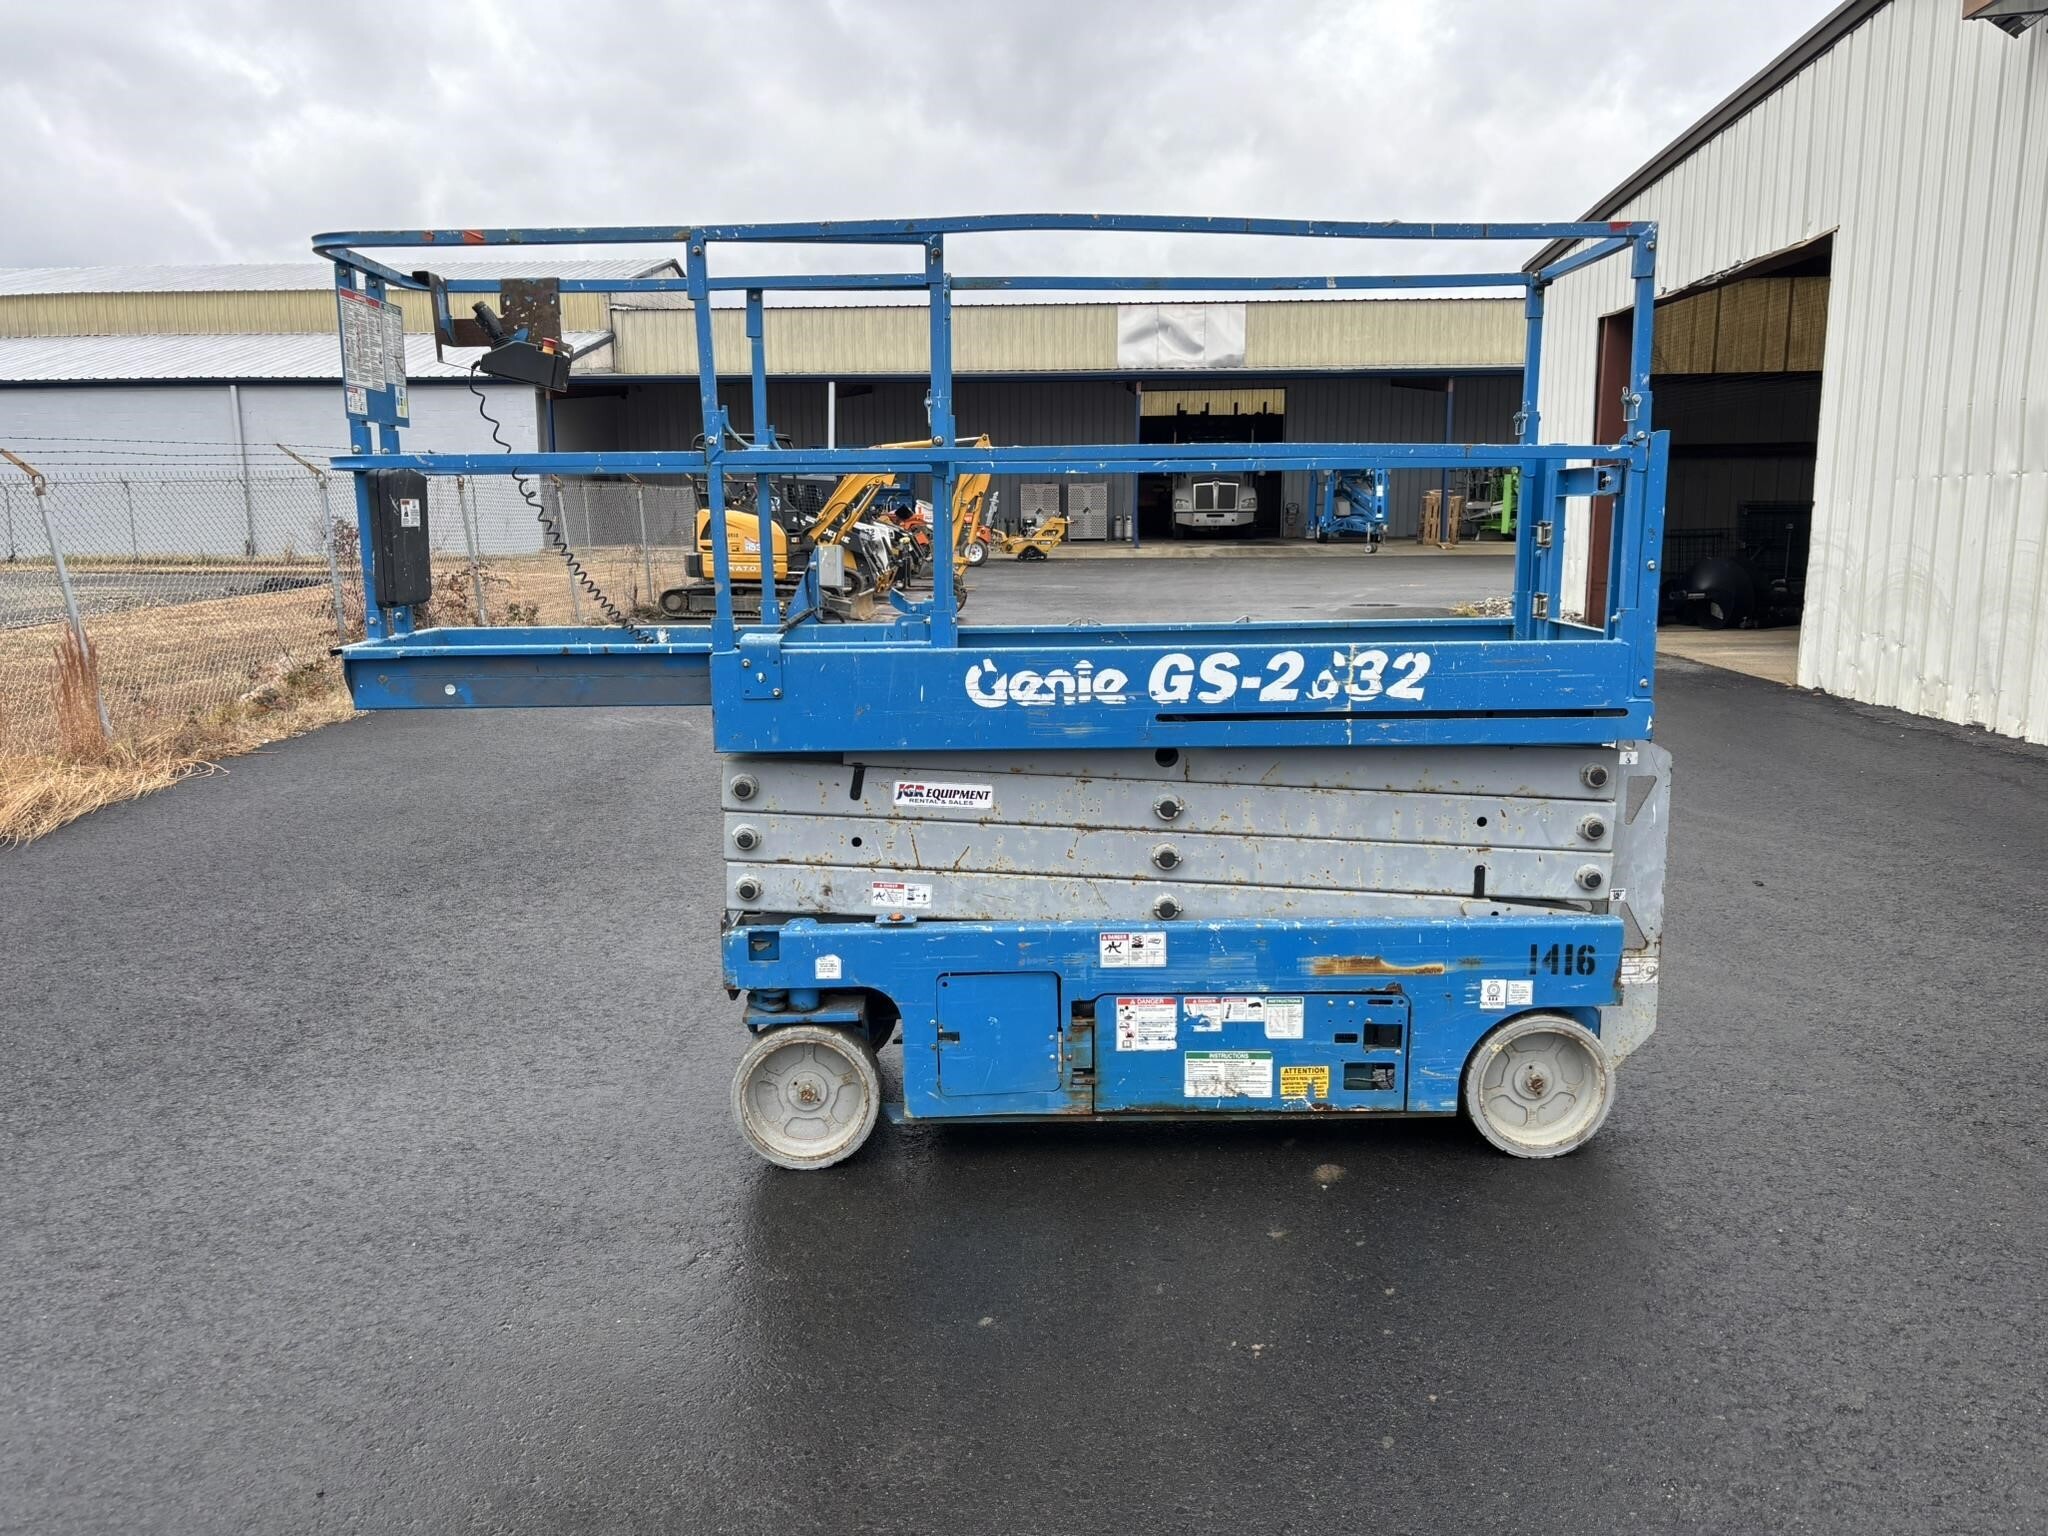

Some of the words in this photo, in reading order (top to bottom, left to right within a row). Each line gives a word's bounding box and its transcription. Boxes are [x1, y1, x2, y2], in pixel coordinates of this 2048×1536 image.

[965, 658, 1128, 708] Genie
[896, 784, 925, 800] JGR
[926, 788, 991, 801] EQUIPMENT
[1529, 944, 1595, 976] 1416
